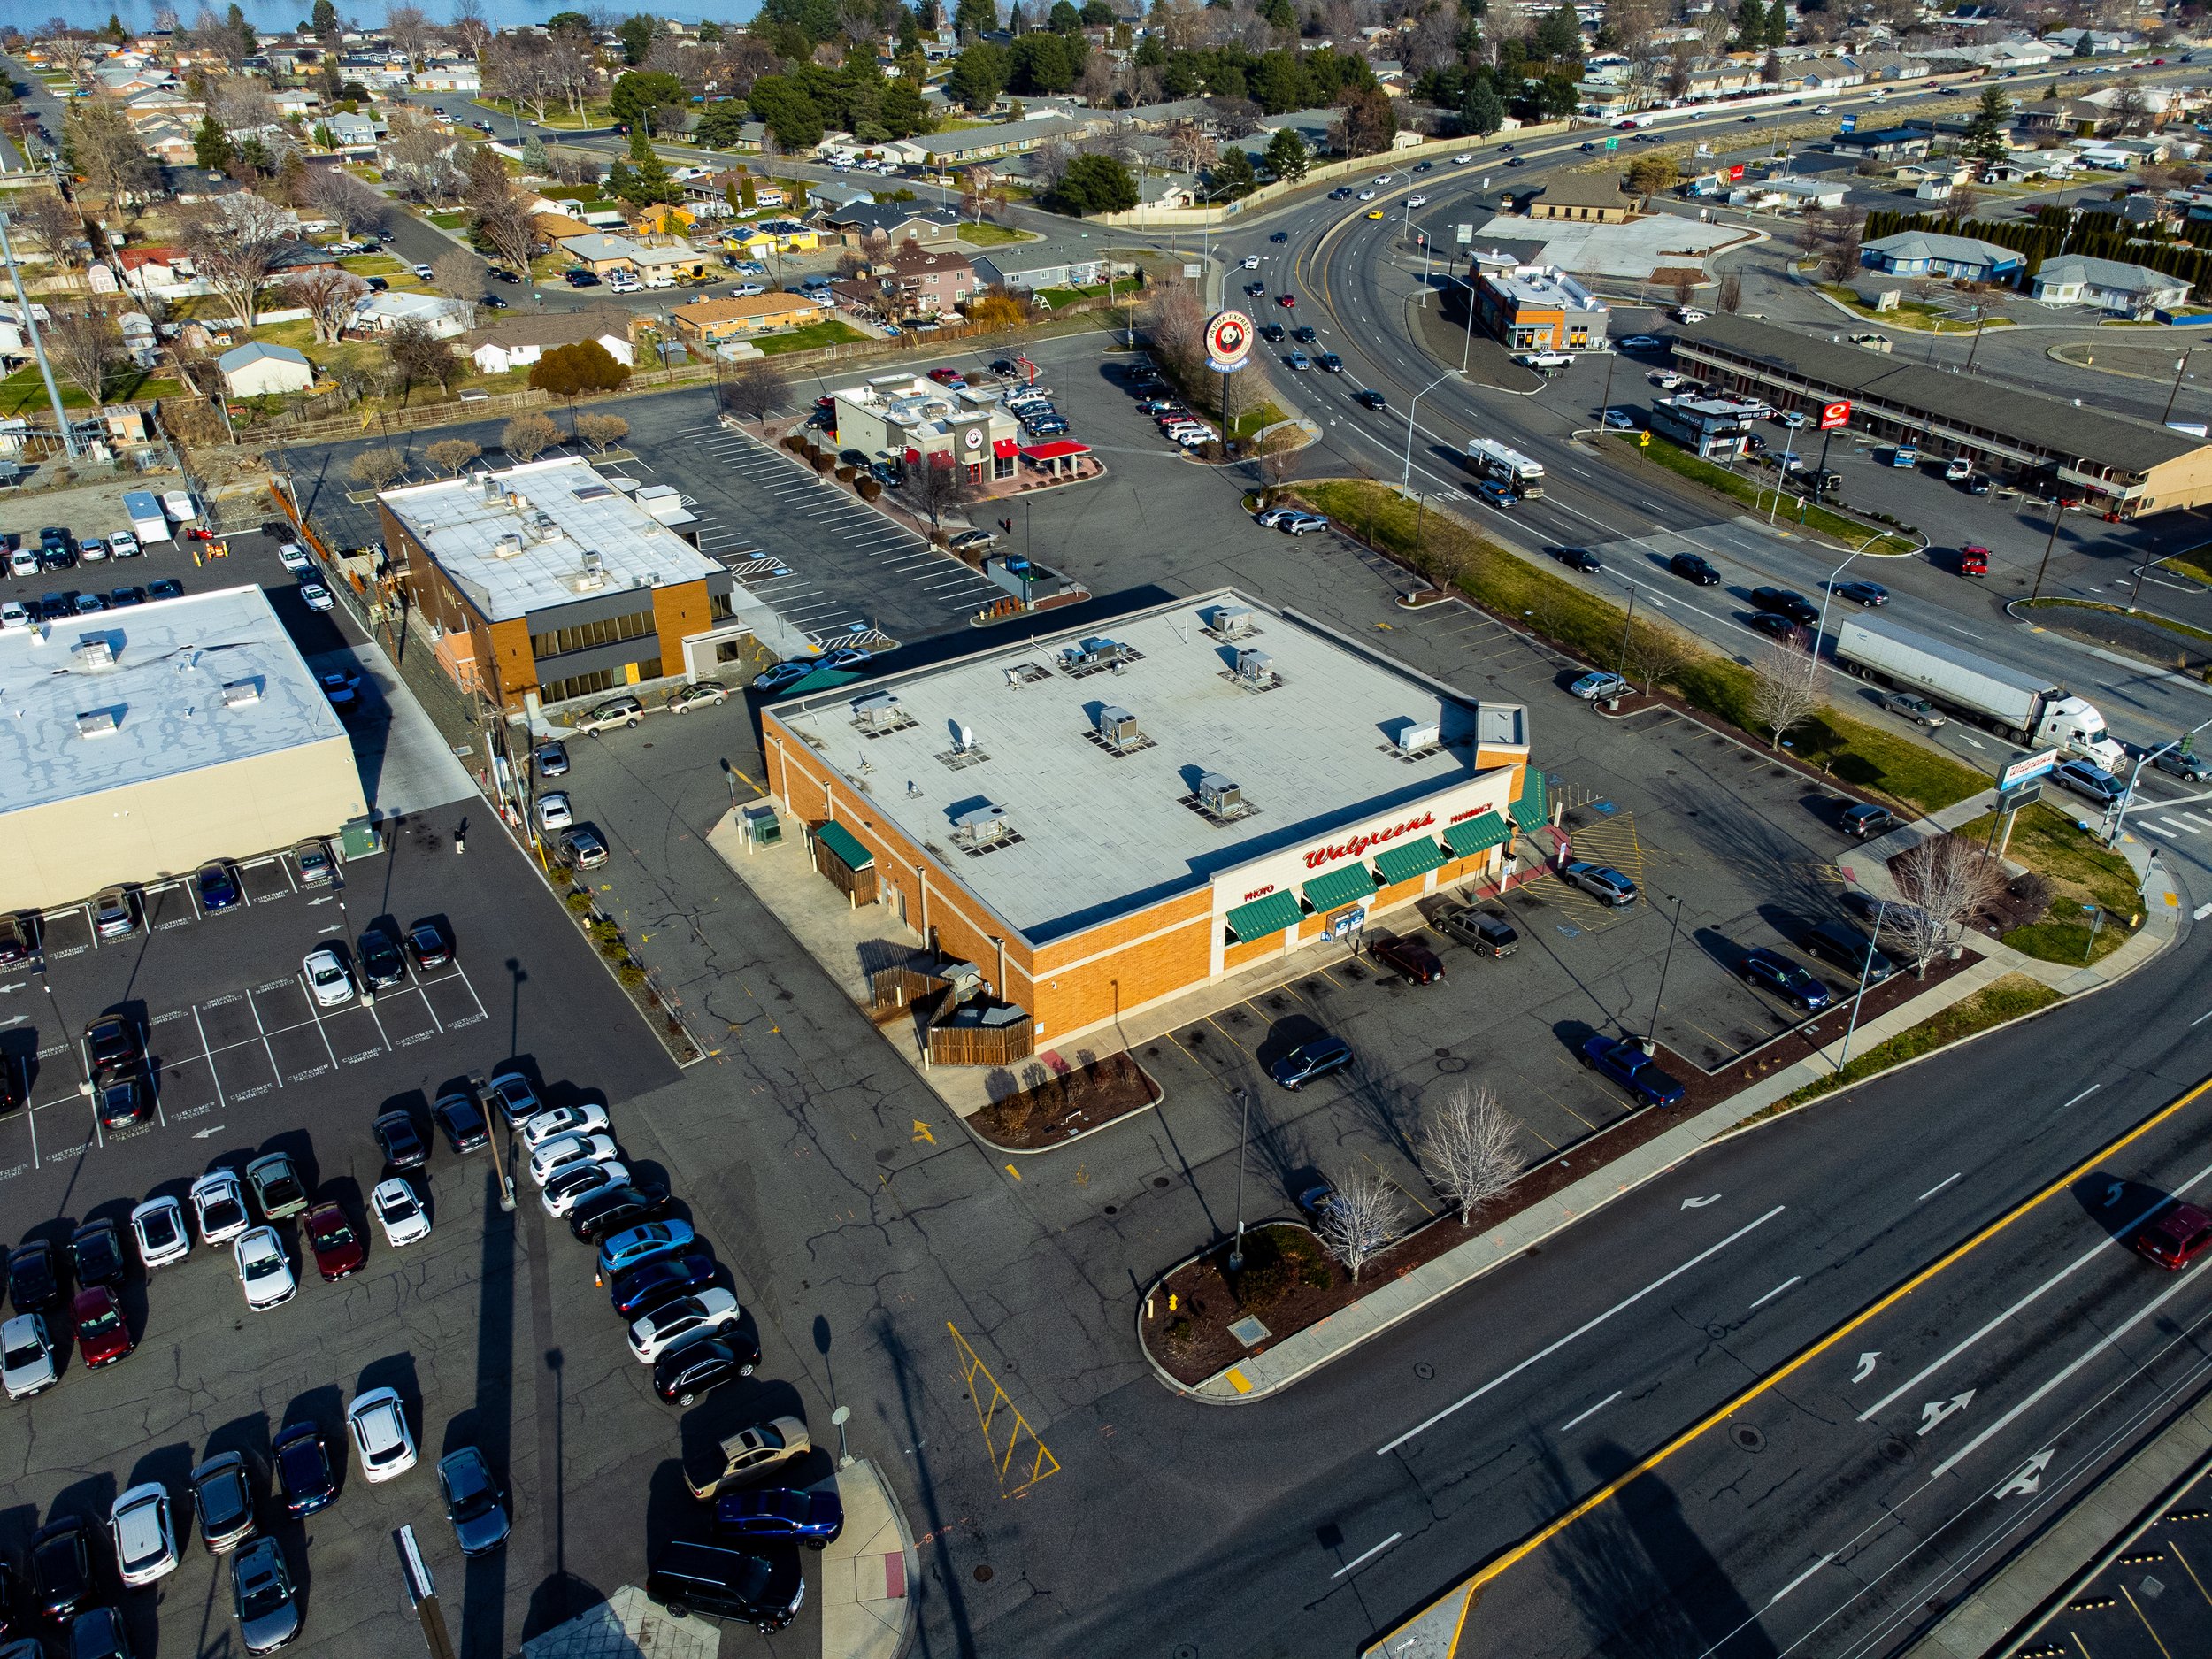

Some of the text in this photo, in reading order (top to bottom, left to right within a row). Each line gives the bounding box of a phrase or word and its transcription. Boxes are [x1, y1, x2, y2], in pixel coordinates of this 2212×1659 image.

[1209, 314, 1251, 339] PANDA EXPRESS
[1231, 358, 1248, 370] THRU
[1450, 802, 1493, 824] PHARMACY
[1302, 810, 1436, 869] Walgreens
[301, 876, 334, 889] CUSTOME
[1244, 884, 1274, 902] PHOTO
